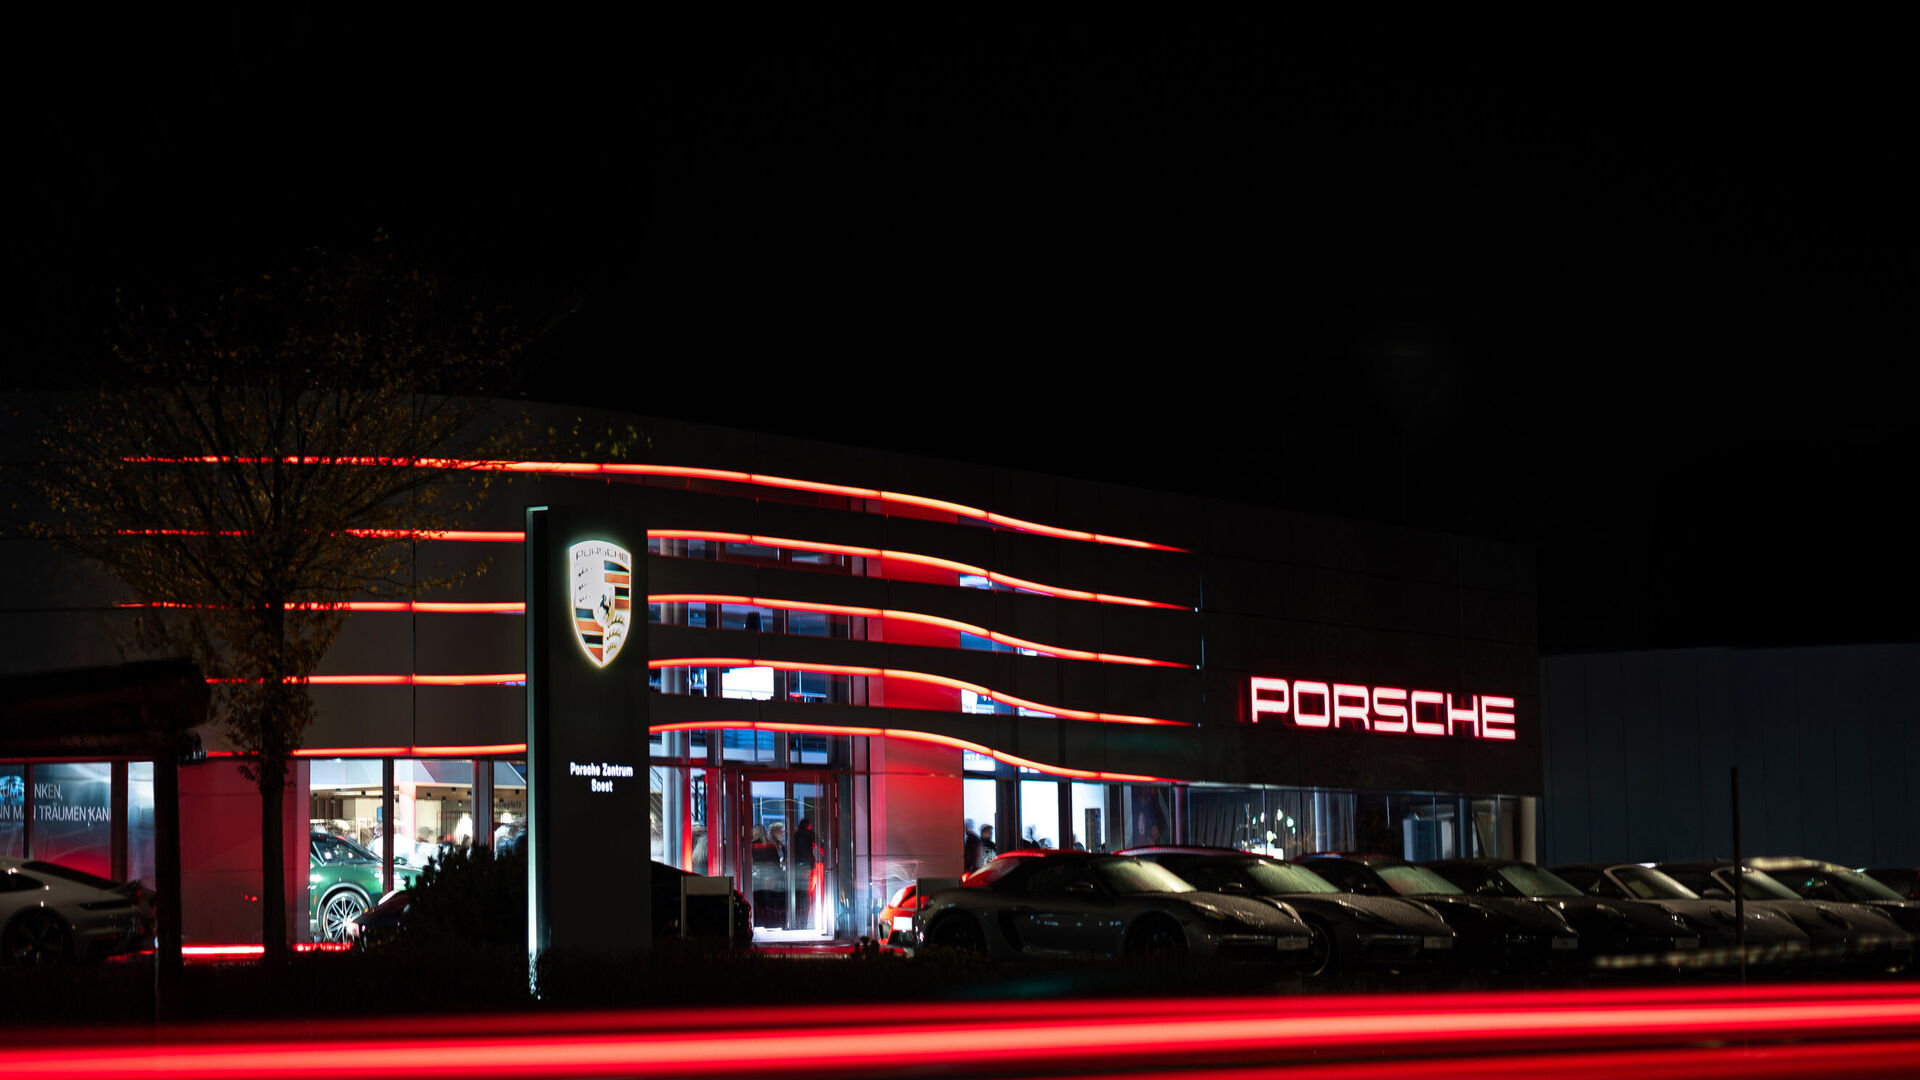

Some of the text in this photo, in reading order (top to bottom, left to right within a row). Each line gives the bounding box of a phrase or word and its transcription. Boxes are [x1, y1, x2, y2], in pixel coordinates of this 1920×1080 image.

[1250, 676, 1517, 740] PORSCHE
[569, 761, 633, 777] Porsche Zentrum
[39, 802, 87, 821] TRÄUMEN
[89, 807, 111, 822] KAN
